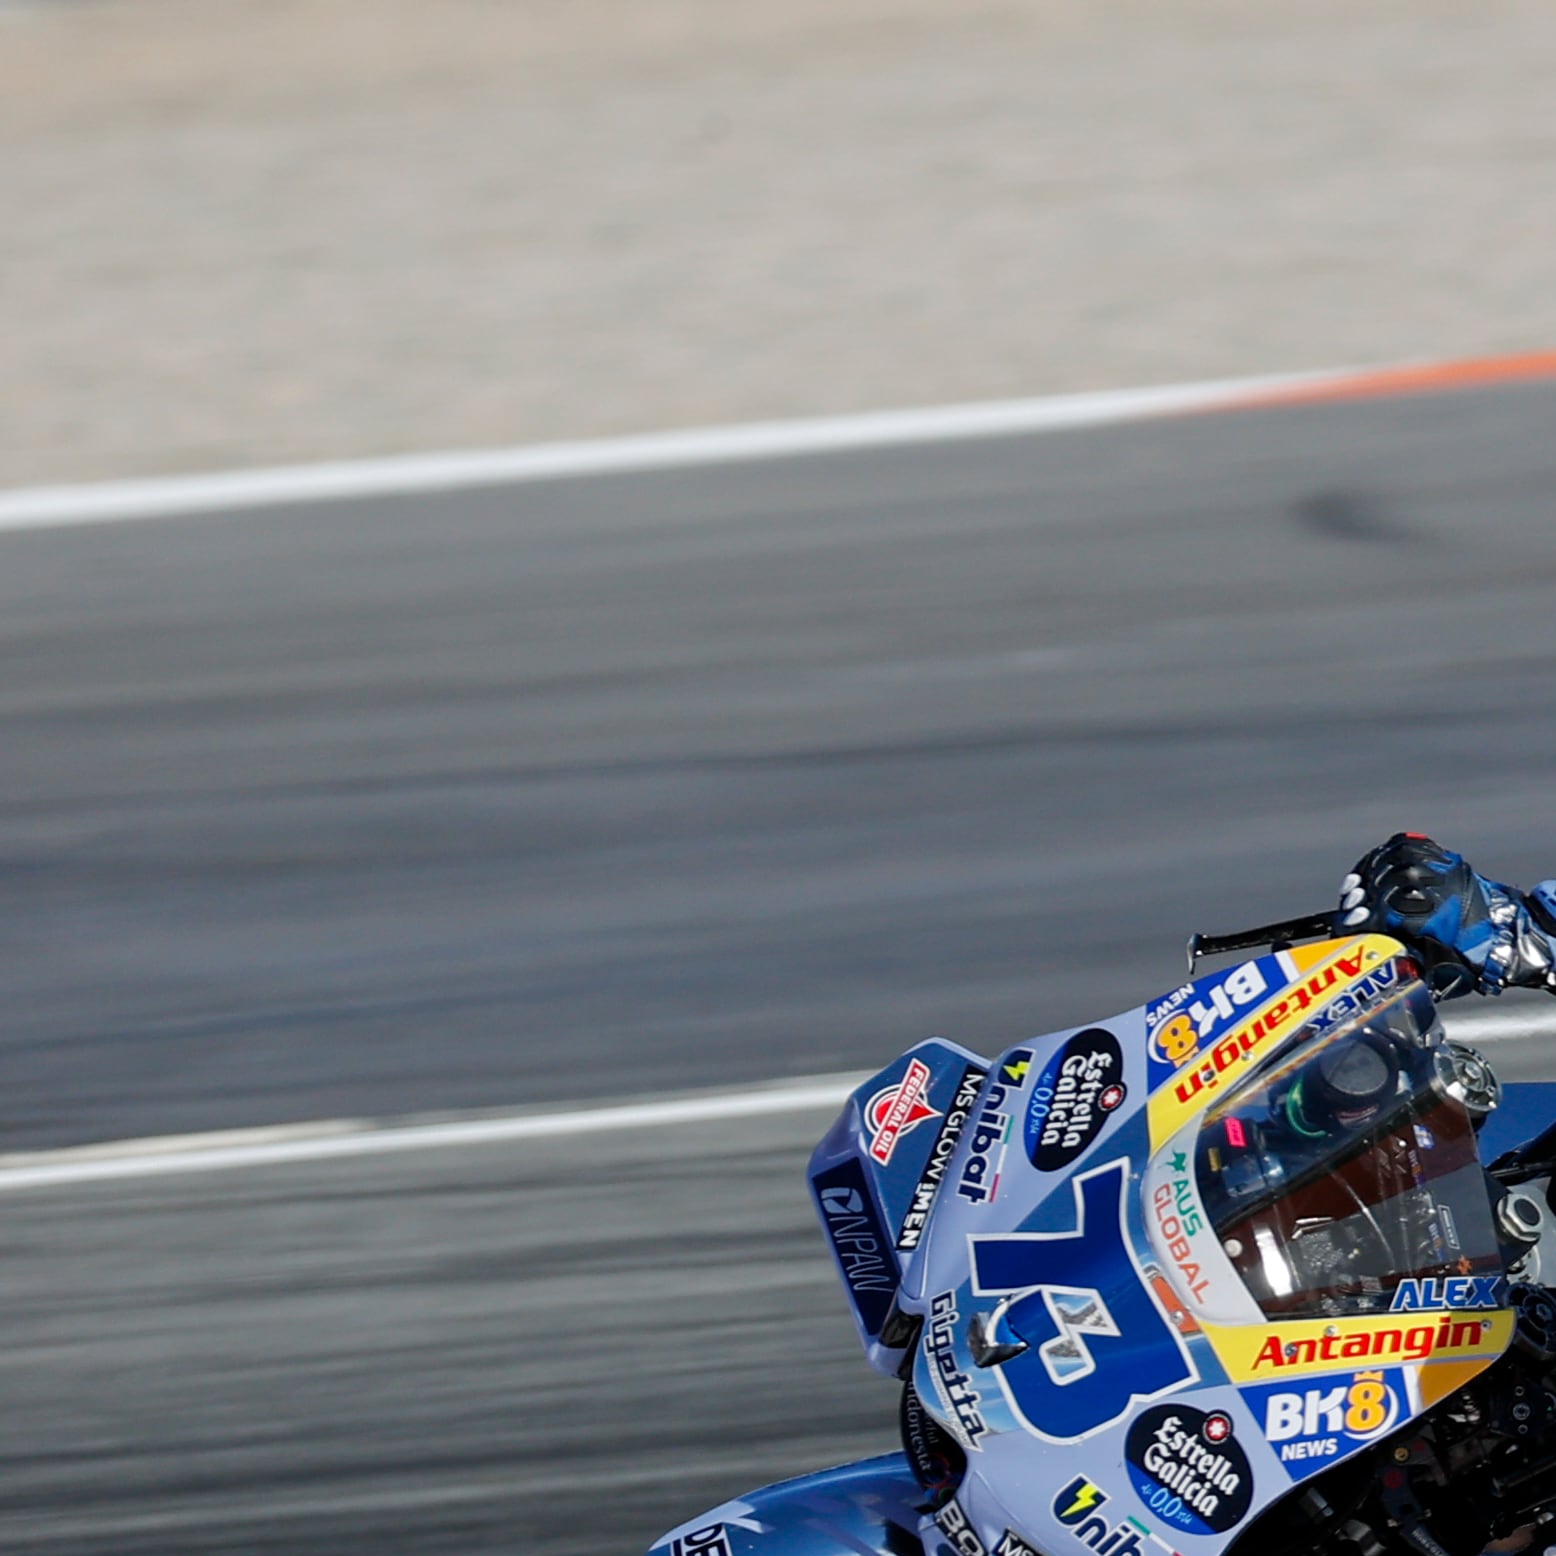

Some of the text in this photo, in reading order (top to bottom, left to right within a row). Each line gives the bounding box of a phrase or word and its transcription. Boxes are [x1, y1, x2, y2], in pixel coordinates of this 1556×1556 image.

[1146, 983, 1196, 1027] NEWS
[1152, 961, 1268, 1064] BK8
[1174, 945, 1365, 1104] Antangin
[1306, 957, 1398, 1033] ALEX
[875, 1063, 926, 1161] FEDERAL OIL
[956, 1073, 985, 1111] MS
[1041, 1055, 1087, 1146] Galicia
[1062, 1050, 1113, 1148] Estrella
[927, 1110, 966, 1184] GLOW
[1153, 1183, 1214, 1305] GLOBAL
[1174, 1178, 1204, 1237] AUS
[826, 1214, 894, 1294] NPAW
[1389, 1276, 1502, 1311] ALEX
[1251, 1317, 1483, 1370] Antangin
[1266, 1376, 1388, 1441] BK8
[1143, 1442, 1220, 1518] Galicia
[1153, 1416, 1240, 1496] Estrella
[1281, 1438, 1338, 1461] NEWS
